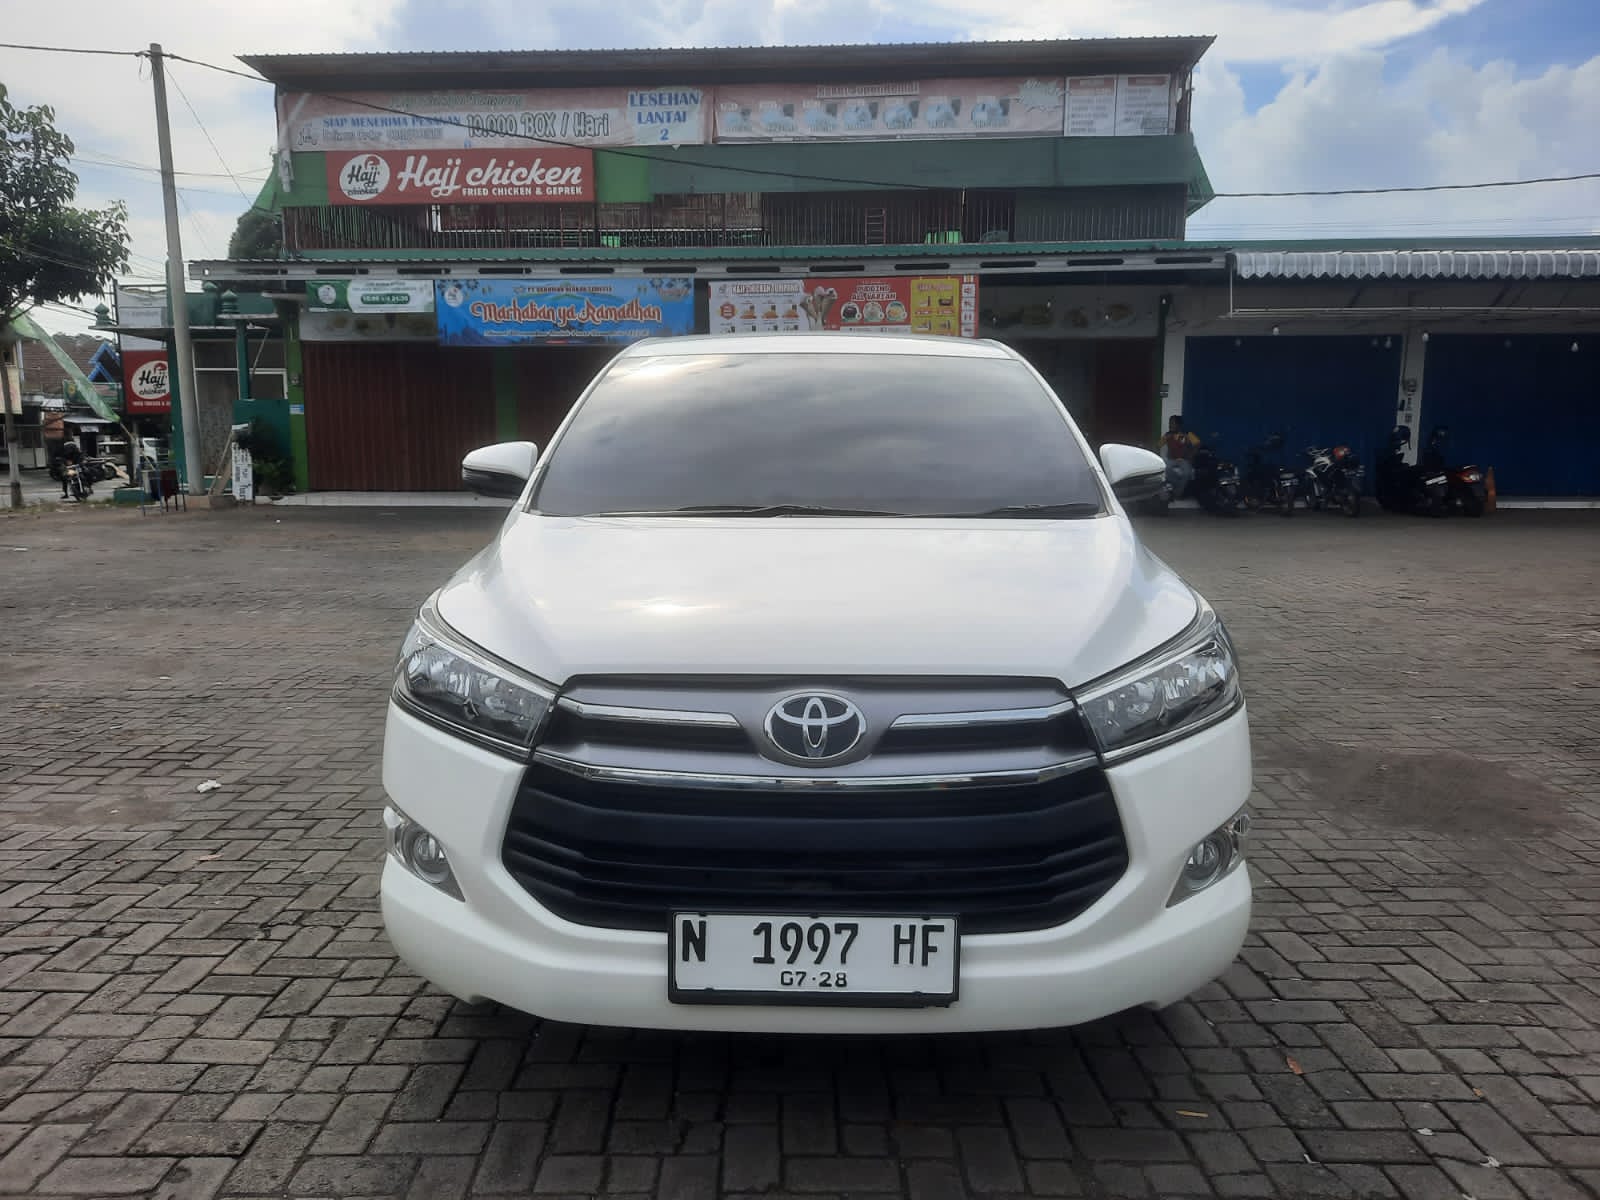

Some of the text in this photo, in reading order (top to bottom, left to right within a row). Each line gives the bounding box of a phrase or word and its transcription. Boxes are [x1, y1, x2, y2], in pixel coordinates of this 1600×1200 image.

[630, 91, 700, 107] LESEHAN
[466, 112, 518, 138] 10.000
[521, 111, 556, 137] BOX
[573, 111, 610, 137] Hari
[637, 110, 687, 125] LANTAI
[660, 128, 669, 141] 2
[396, 154, 583, 198] Hajj chicken
[462, 187, 489, 197] FRIED
[492, 187, 532, 196] CHICKEN
[546, 186, 583, 196] GEPREK
[470, 298, 662, 327] Marhaban ya Ramadhan
[681, 920, 945, 967] N 1997 HF
